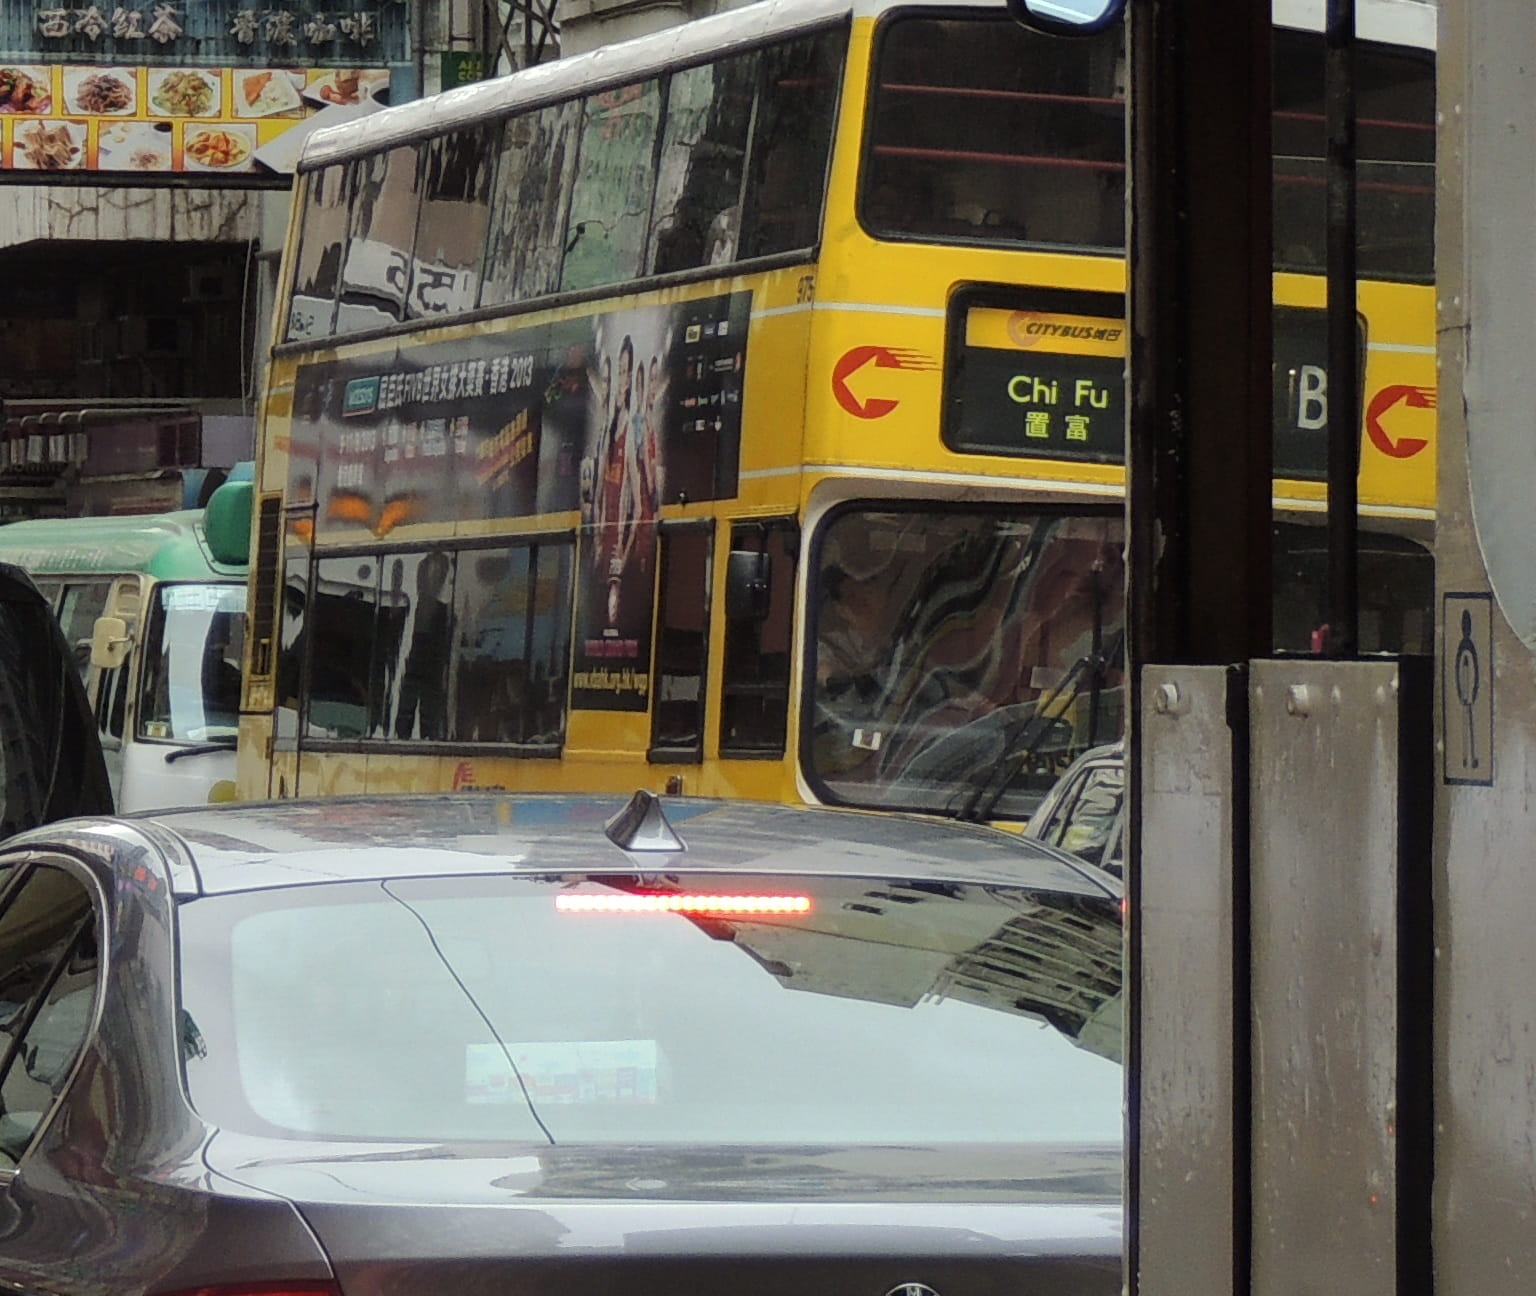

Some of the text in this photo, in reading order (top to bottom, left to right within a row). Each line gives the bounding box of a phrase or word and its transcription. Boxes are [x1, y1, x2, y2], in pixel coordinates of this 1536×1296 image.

[1007, 375, 1109, 409] Chi Fu
[1024, 411, 1091, 441] 置富
